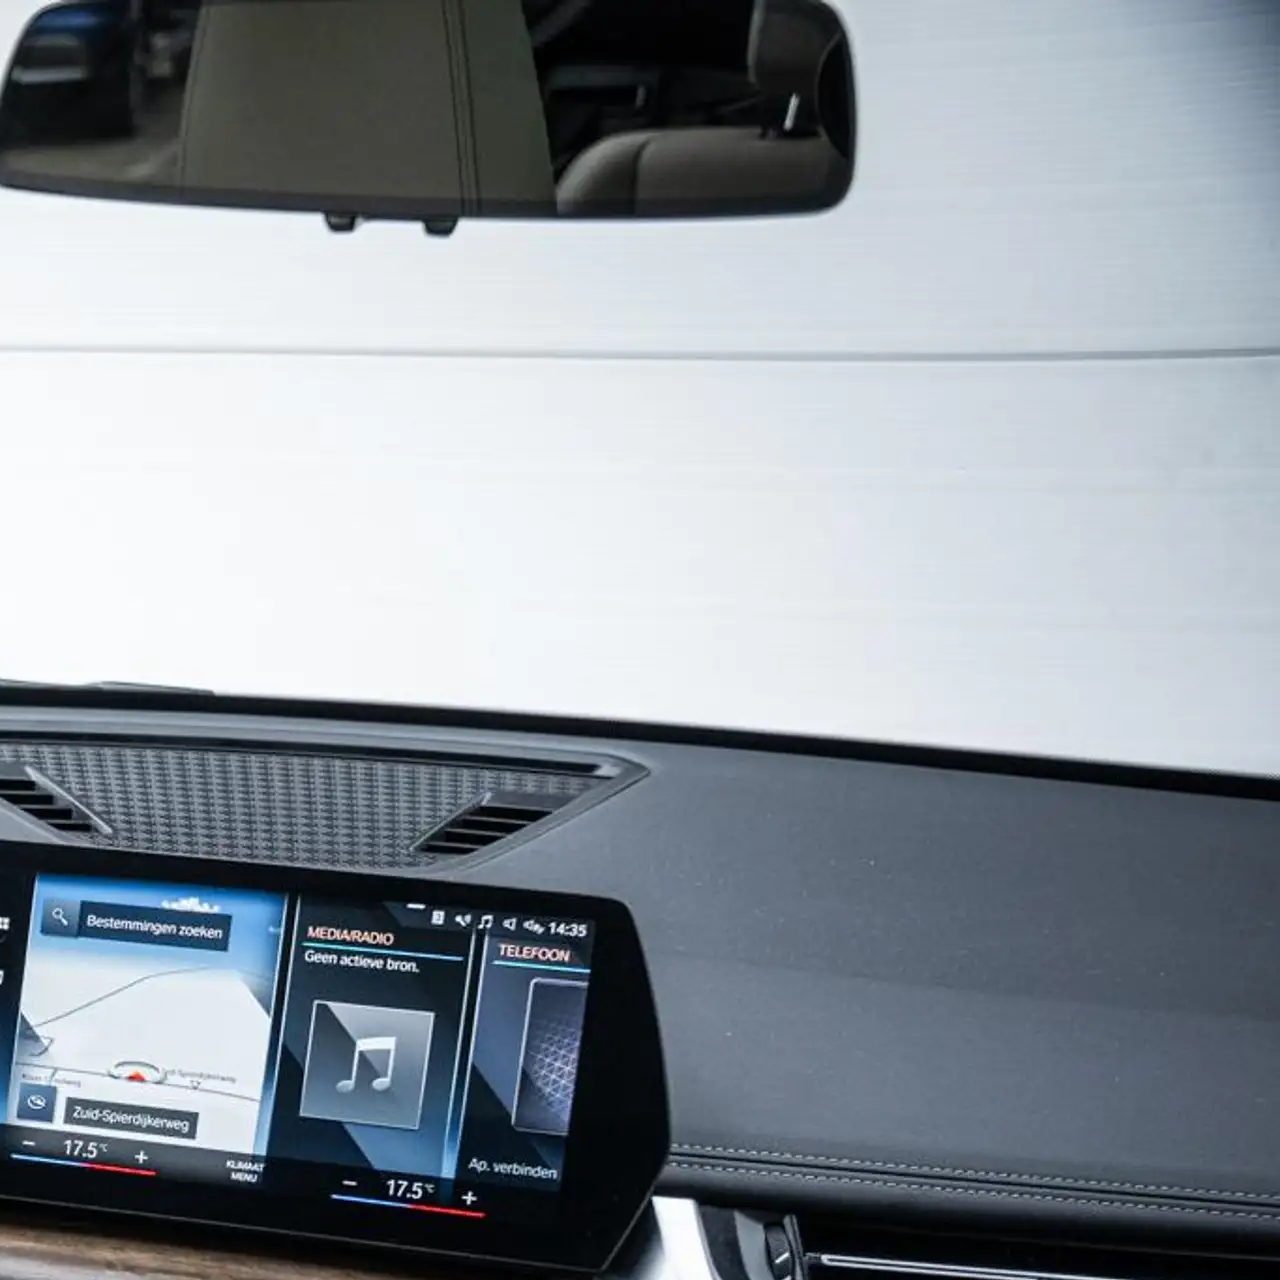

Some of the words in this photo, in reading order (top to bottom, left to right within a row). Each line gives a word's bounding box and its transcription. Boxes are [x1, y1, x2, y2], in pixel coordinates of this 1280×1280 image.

[86, 914, 178, 937] Bestemmingen
[177, 925, 224, 940] zoeken
[306, 925, 395, 946] MEDIA/RADIO
[547, 921, 588, 938] 14:35
[304, 949, 338, 965] Geen
[338, 953, 384, 970] actieve
[385, 957, 421, 974] bron.
[498, 943, 571, 963] TELEFOON
[72, 1105, 190, 1134] Zuid-Spierdijkerweg
[230, 1171, 258, 1183] MENU
[467, 1157, 491, 1172] Ap.
[493, 1162, 558, 1181] verbinden
